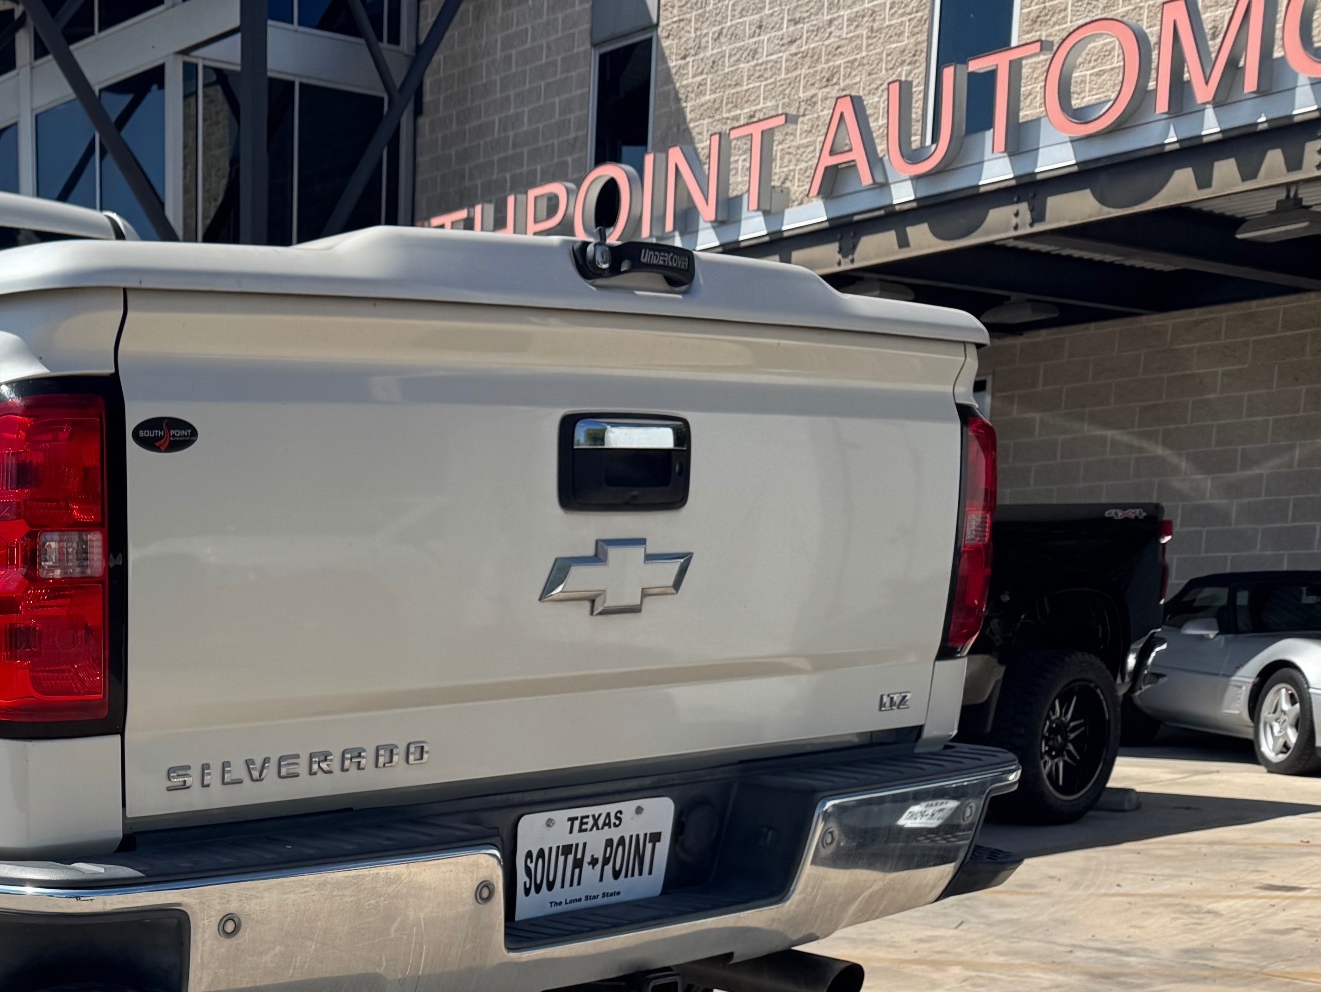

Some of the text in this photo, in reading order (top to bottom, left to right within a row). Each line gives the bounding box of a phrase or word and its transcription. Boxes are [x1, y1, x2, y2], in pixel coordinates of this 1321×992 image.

[138, 429, 192, 437] SOUTH POINT
[878, 691, 912, 711] LTZ
[166, 740, 430, 792] SILVERADO
[566, 809, 624, 835] TEXAS
[523, 831, 663, 898] SOUTH POINT
[548, 889, 621, 908] The Lone Star State
